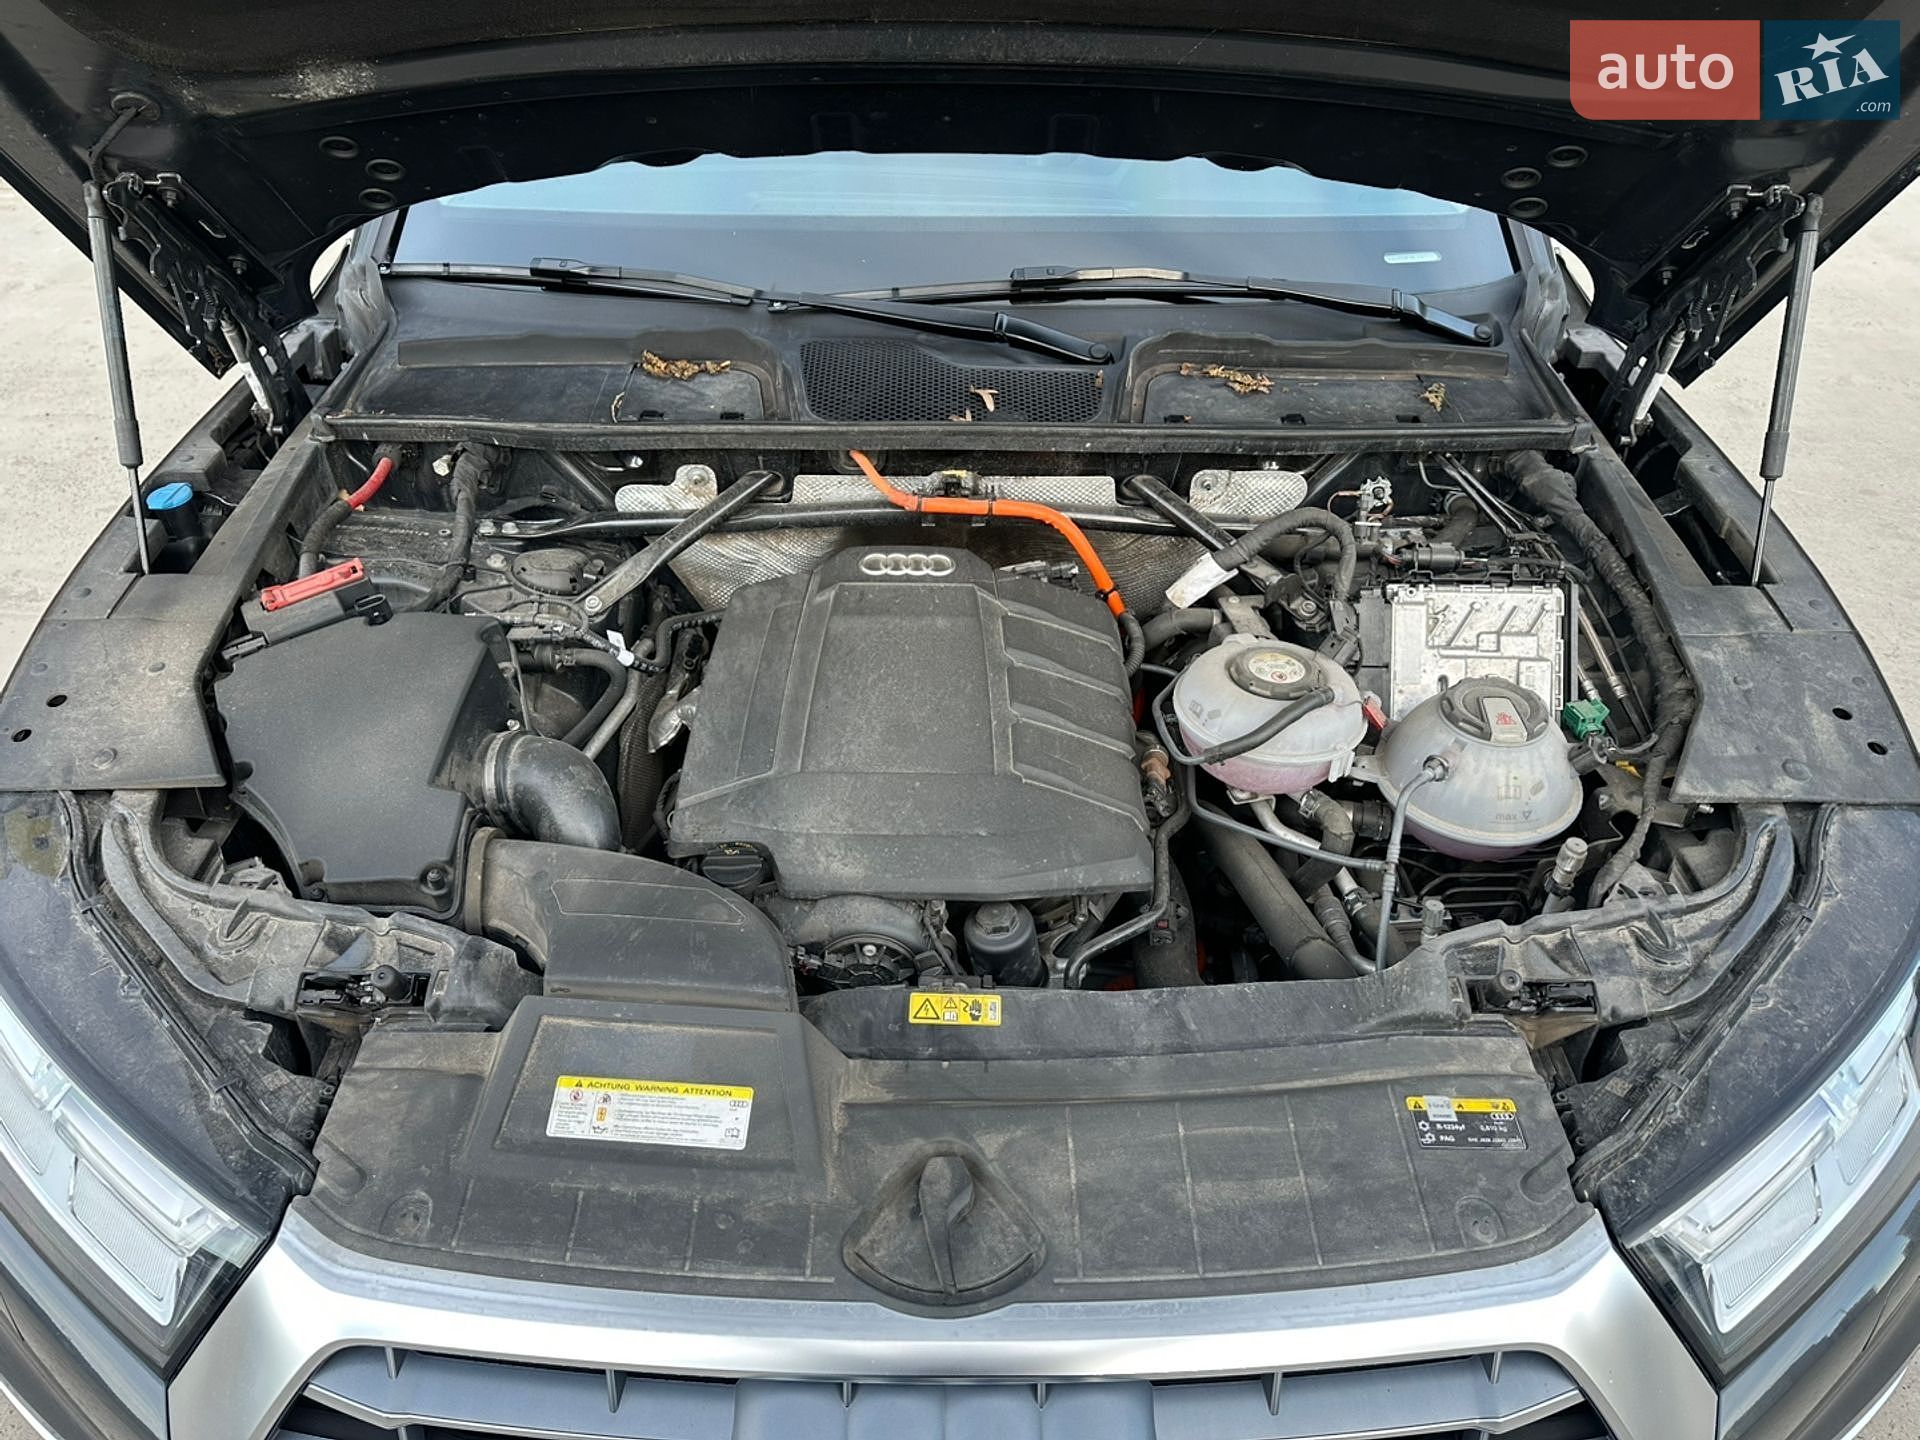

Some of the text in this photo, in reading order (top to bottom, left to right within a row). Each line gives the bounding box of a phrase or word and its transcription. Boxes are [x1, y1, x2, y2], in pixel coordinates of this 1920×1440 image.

[1495, 813, 1518, 821] max
[587, 1080, 732, 1097] ACHTUNG WARNING ATTENTION
